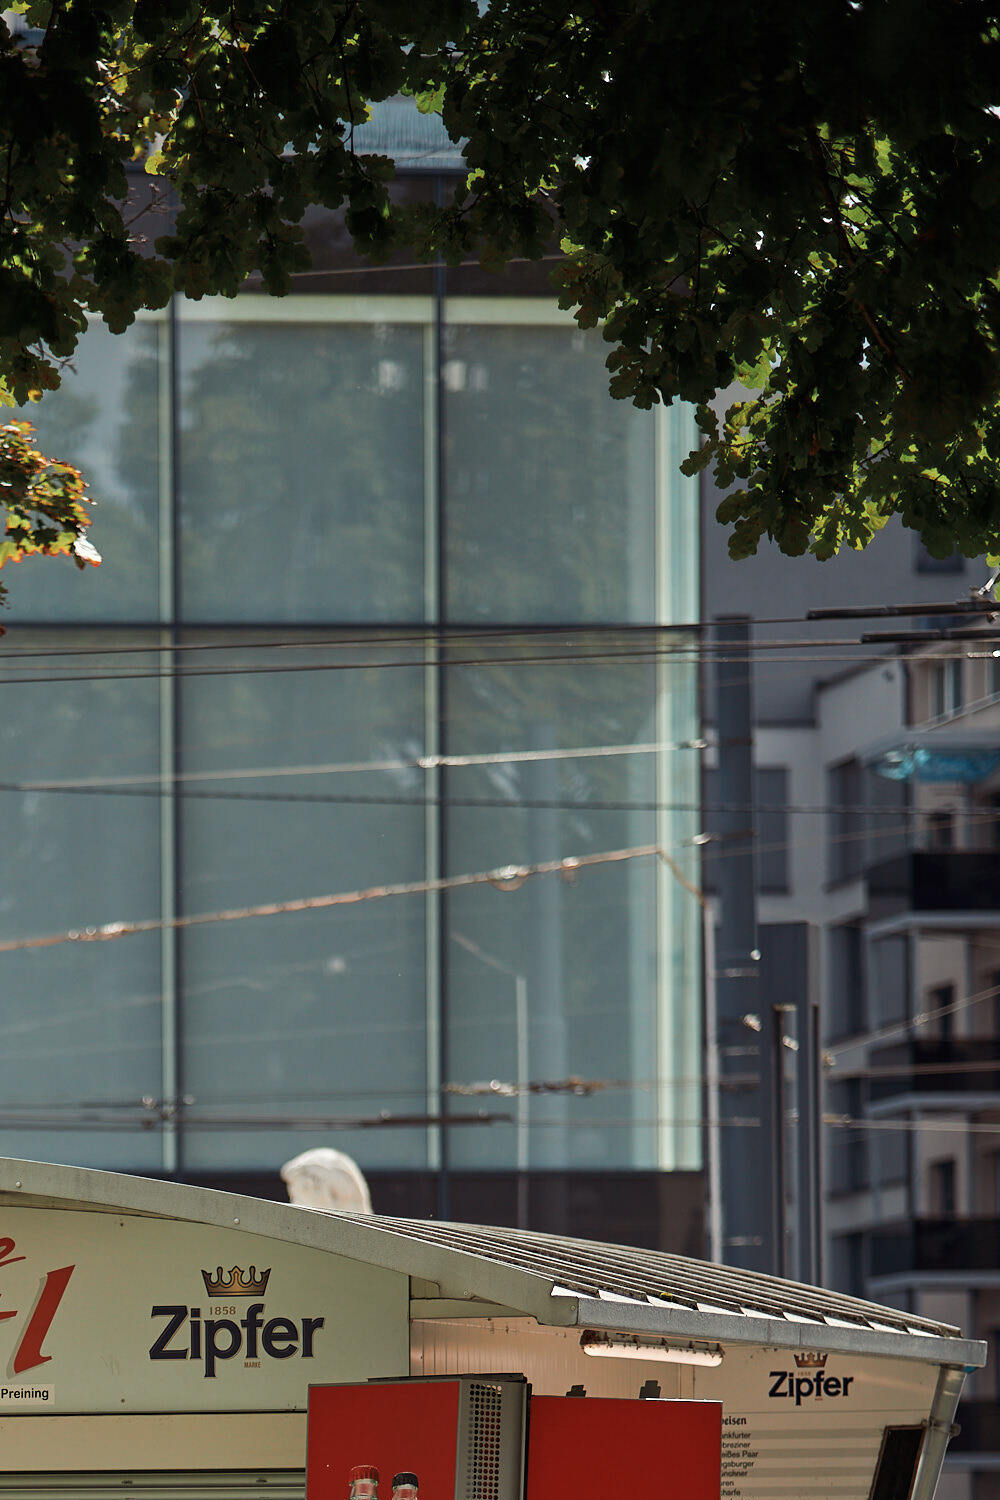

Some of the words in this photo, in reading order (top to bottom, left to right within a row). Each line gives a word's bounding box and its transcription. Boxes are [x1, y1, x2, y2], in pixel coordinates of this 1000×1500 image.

[209, 1306, 236, 1316] 1858
[149, 1303, 325, 1379] Zipfer
[1, 1388, 49, 1401] Preining
[768, 1370, 854, 1406] Zipfer
[742, 1450, 758, 1458] Paar
